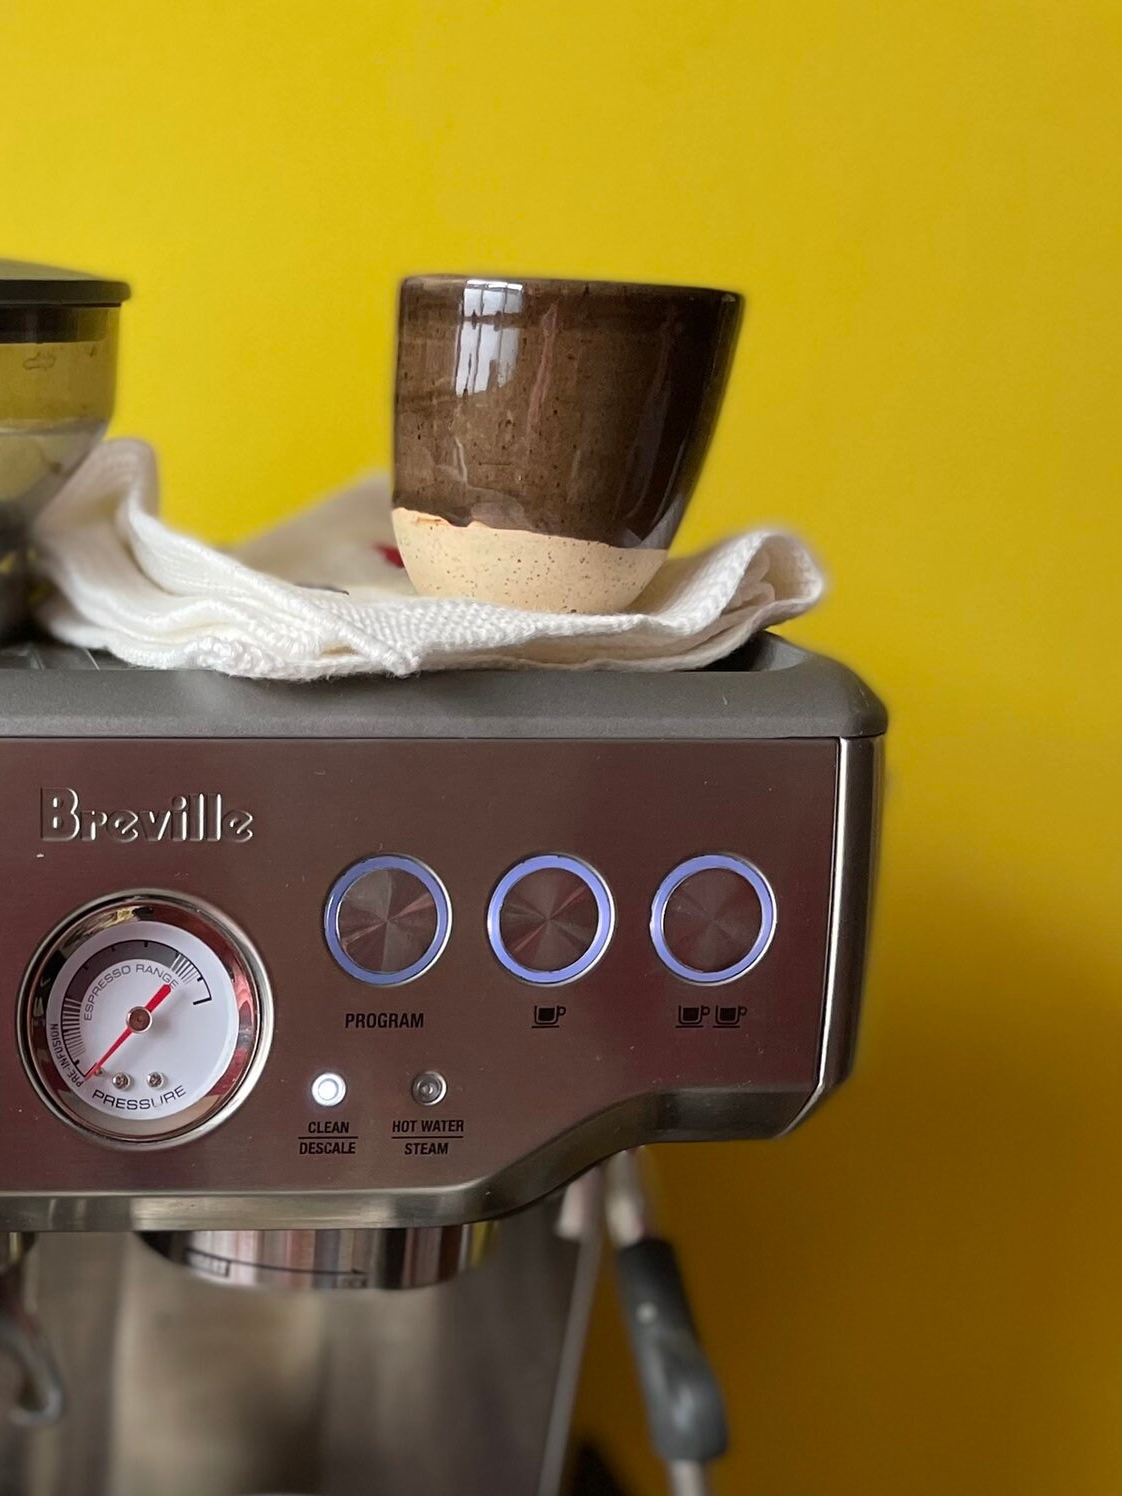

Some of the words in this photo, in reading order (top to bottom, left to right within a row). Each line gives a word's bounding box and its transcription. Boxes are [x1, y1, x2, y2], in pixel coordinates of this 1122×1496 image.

[40, 786, 253, 843] Breville
[84, 965, 131, 1021] ESPRESSO
[136, 964, 179, 989] RANGE
[345, 1013, 424, 1029] PROGRAM
[50, 1023, 84, 1087] PRE-INFUSION
[92, 1085, 187, 1110] PRESSURE
[308, 1121, 350, 1134] CLEAN
[392, 1120, 417, 1133] HOT
[422, 1119, 464, 1132] WATER
[299, 1142, 356, 1155] DESCALE
[404, 1142, 449, 1155] STEAM
